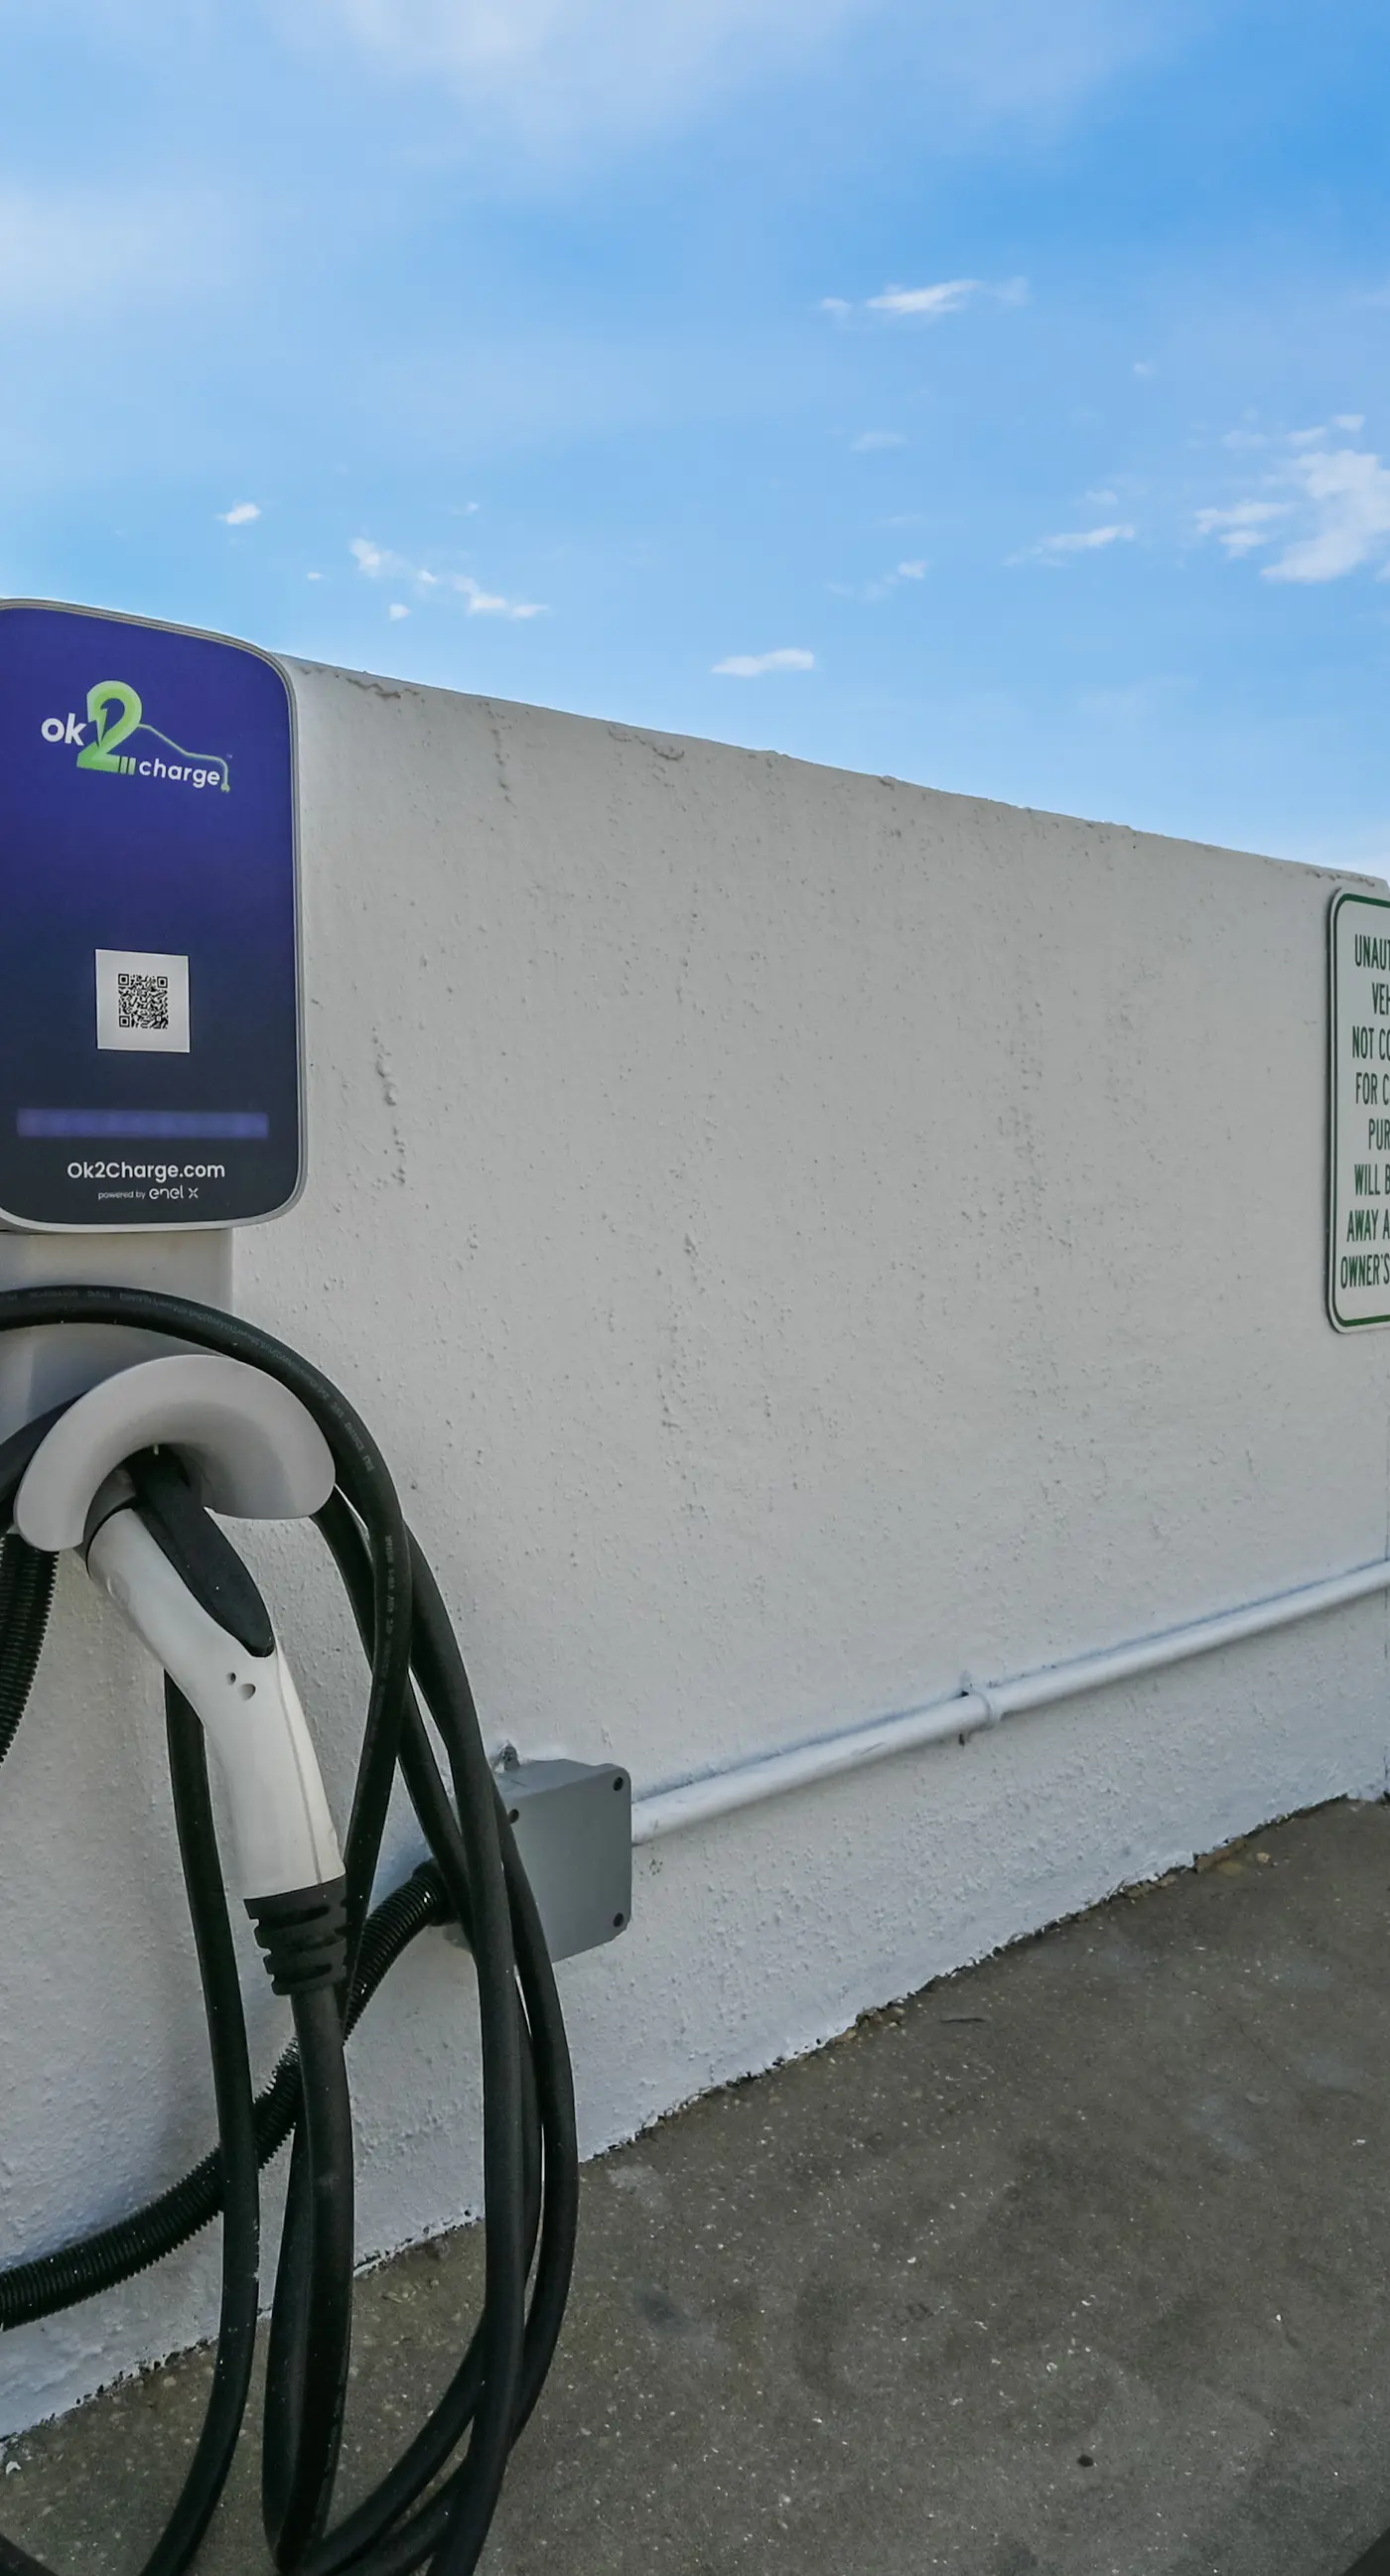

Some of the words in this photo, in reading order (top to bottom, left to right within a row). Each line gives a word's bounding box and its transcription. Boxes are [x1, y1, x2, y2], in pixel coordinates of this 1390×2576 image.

[41, 713, 86, 746] ok
[76, 680, 142, 774] 2
[139, 758, 220, 788] charge
[1352, 1025, 1374, 1059] NOT
[1355, 1072, 1378, 1105] FOR
[1368, 1118, 1390, 1151] PUR
[67, 1161, 225, 1183] Ok2Charge.com
[1354, 1163, 1380, 1195] WILL
[98, 1191, 134, 1200] powered
[135, 1190, 146, 1199] by
[149, 1185, 184, 1199] enel
[1346, 1208, 1379, 1242] AWAY
[1382, 1208, 1390, 1240] A
[1340, 1253, 1390, 1289] OWNER'S
